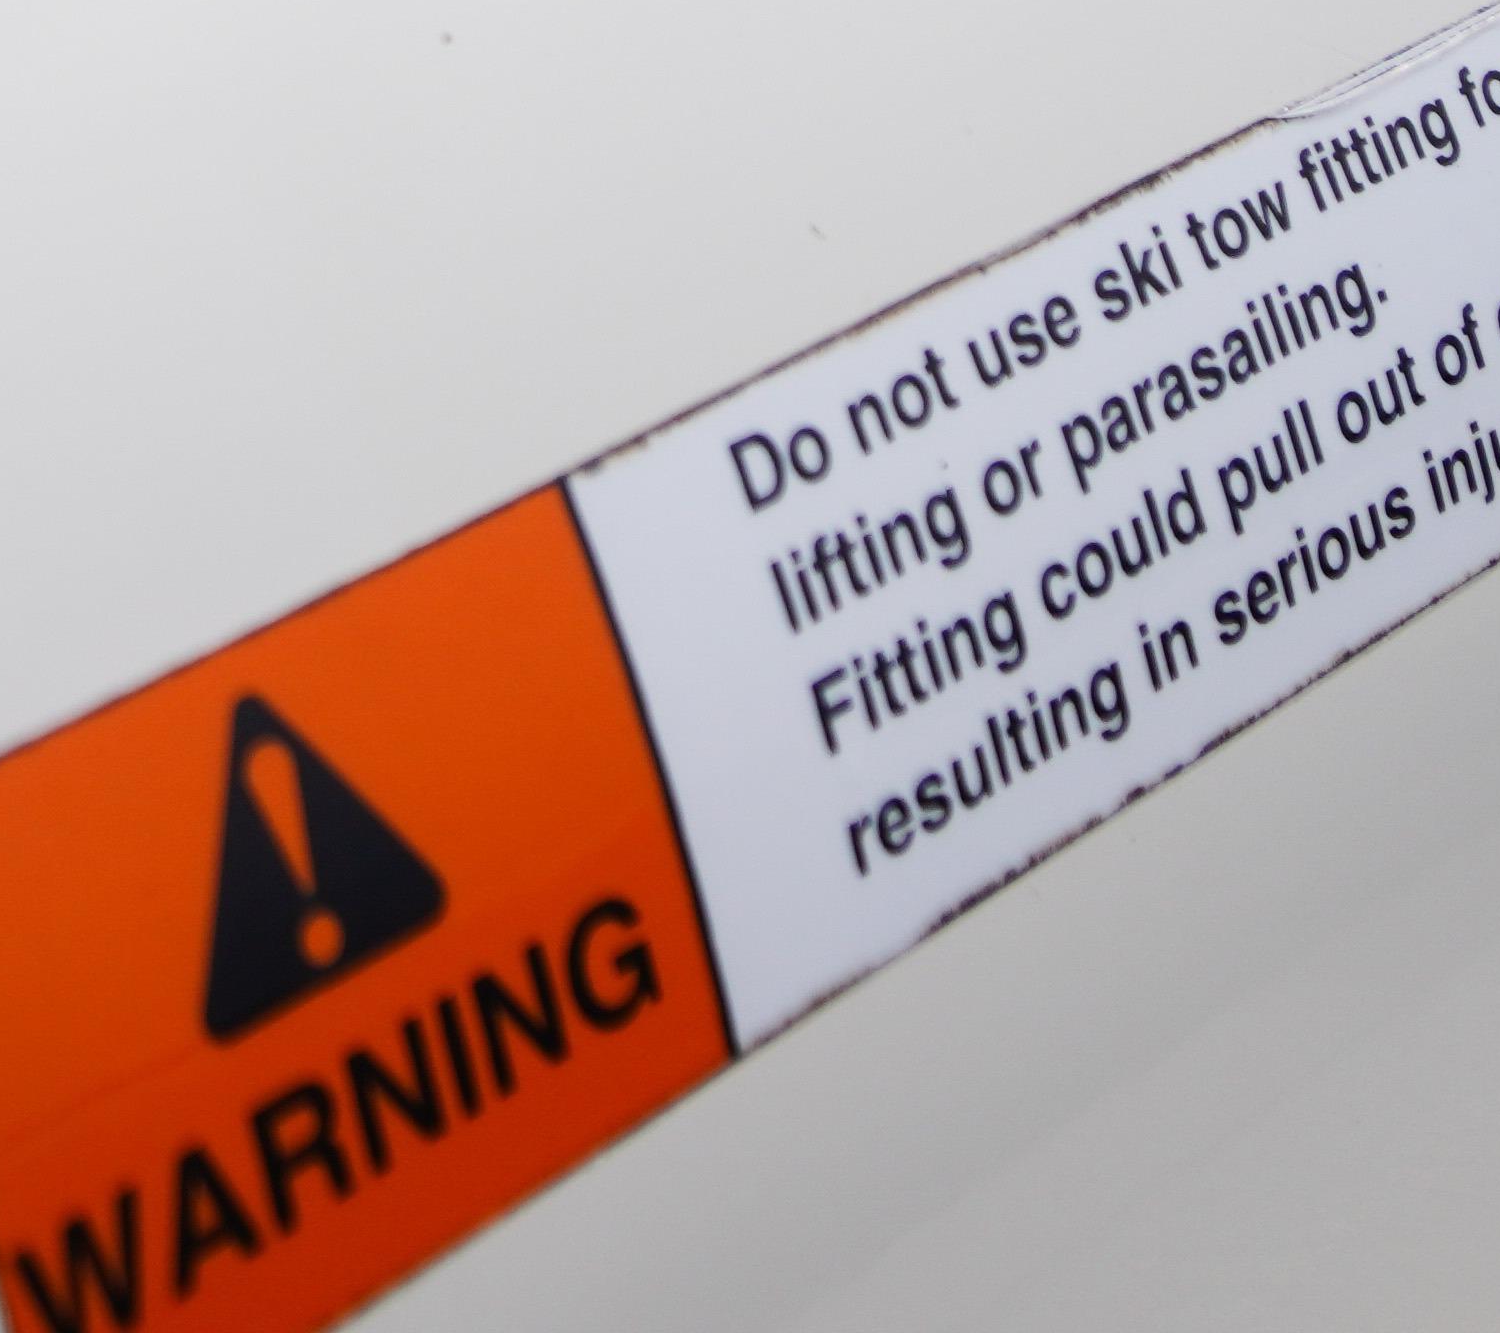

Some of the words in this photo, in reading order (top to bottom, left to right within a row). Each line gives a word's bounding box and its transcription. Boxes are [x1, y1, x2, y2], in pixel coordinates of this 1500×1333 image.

[727, 426, 832, 514] Do
[846, 348, 960, 456] not
[966, 294, 1082, 389] use
[1093, 224, 1183, 323] ski
[1185, 180, 1292, 271] tow
[1298, 98, 1461, 213] fitting
[769, 486, 972, 636] lifting
[981, 439, 1043, 517] or
[1060, 263, 1388, 491] parasailing.
[809, 590, 1028, 757] Fitting
[1039, 467, 1208, 621] could
[1216, 398, 1325, 543] pull
[1336, 346, 1427, 445] out
[1434, 302, 1486, 387] of
[847, 656, 1131, 878] resulting
[1137, 619, 1199, 694] in
[1213, 486, 1416, 647] serious
[15, 895, 662, 1333] WARNING
